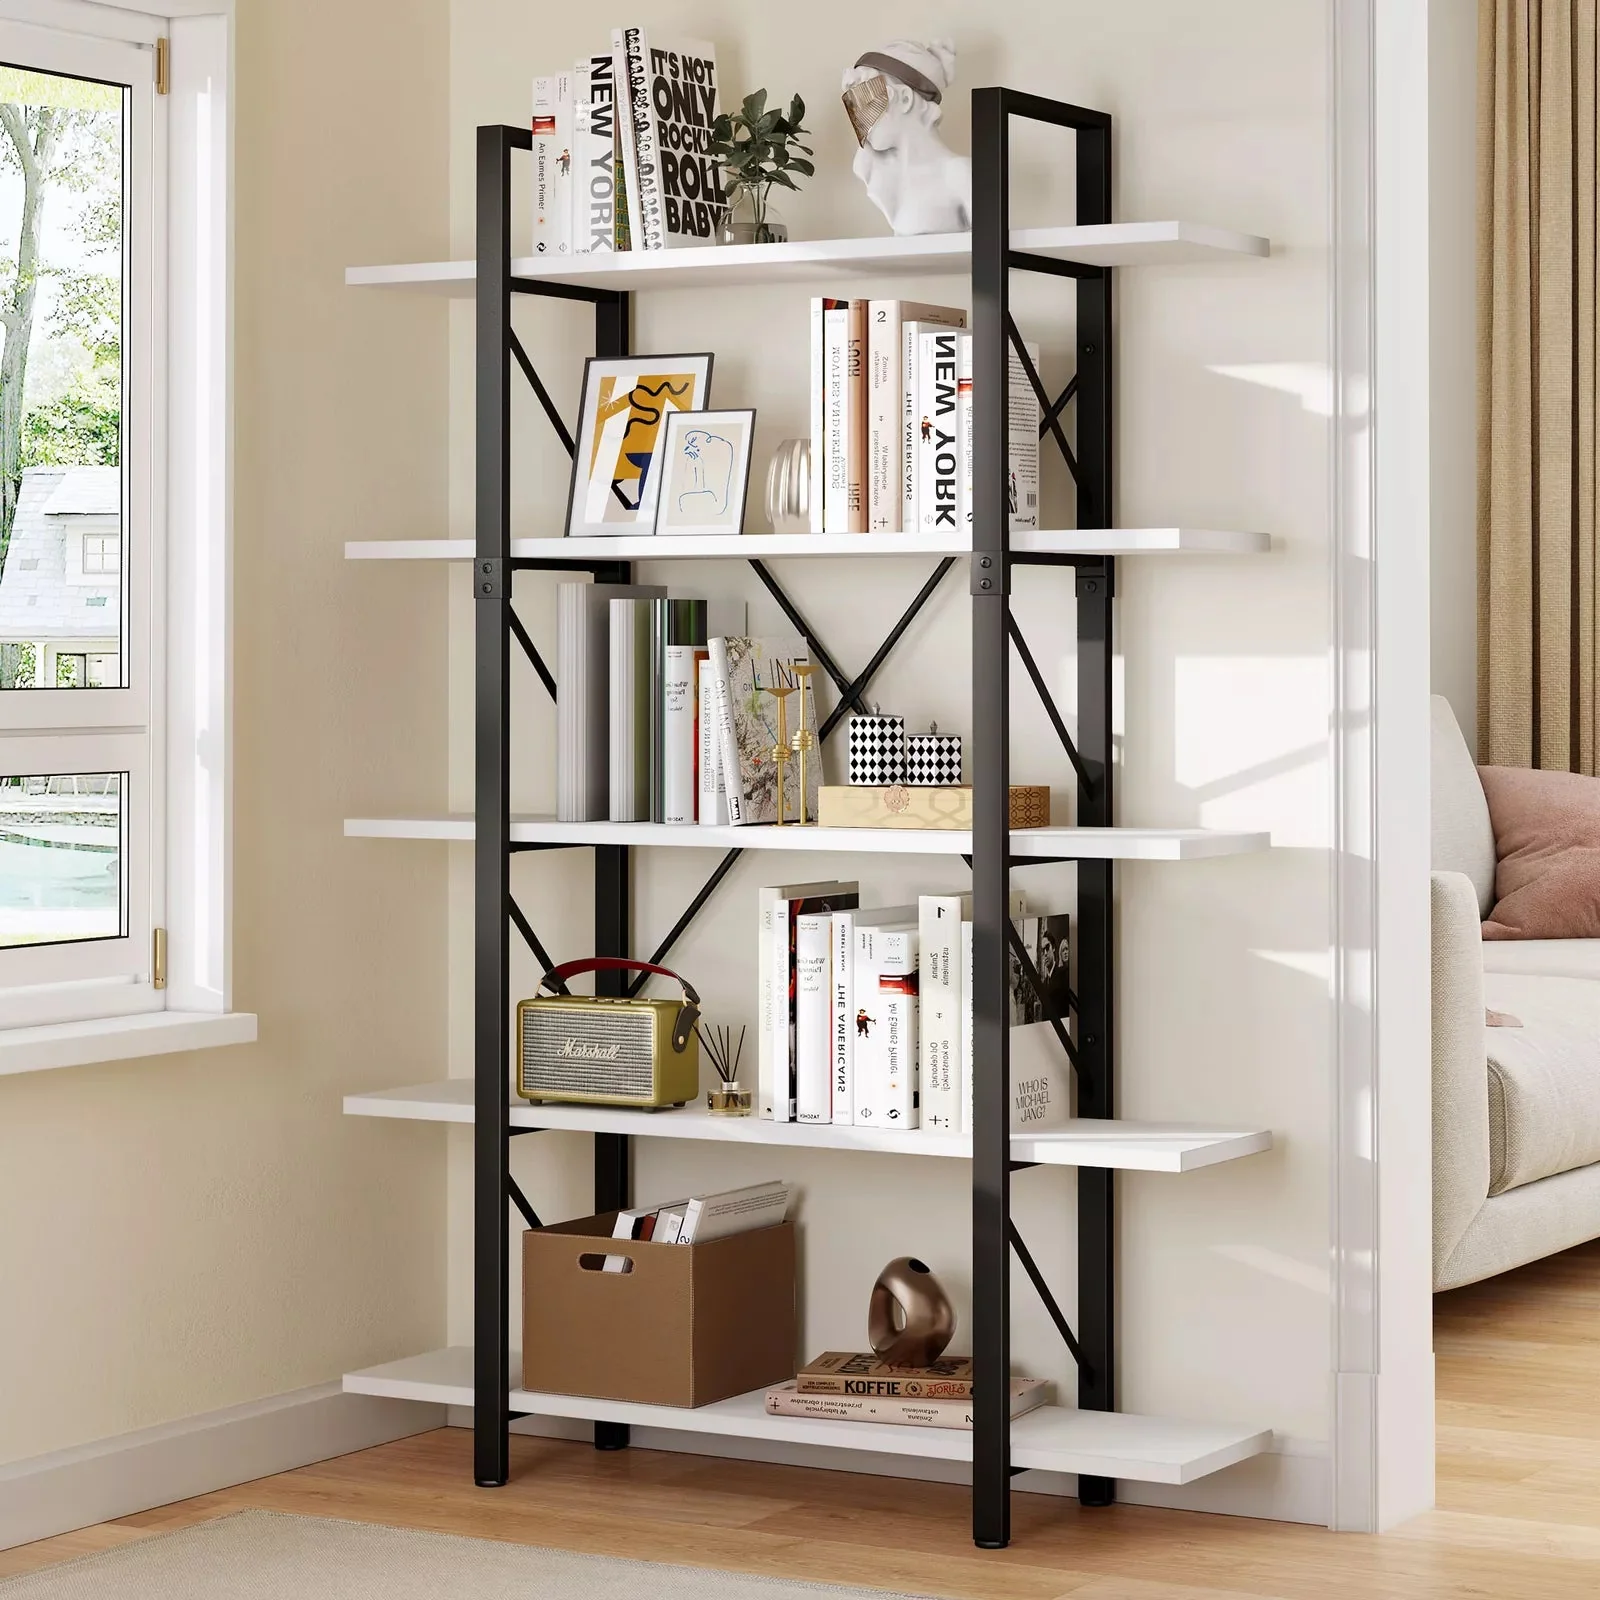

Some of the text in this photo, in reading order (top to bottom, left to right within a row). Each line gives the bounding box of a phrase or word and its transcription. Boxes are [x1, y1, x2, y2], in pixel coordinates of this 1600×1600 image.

[650, 48, 714, 86] IT'S NOT
[652, 75, 717, 130] ONLY
[590, 56, 613, 252] NEW YORK
[538, 143, 546, 210] An Eames Primer
[660, 150, 727, 204] ROLL
[877, 311, 887, 323] 2
[751, 658, 811, 690] LINE
[556, 1037, 621, 1062] Marshall
[1018, 1077, 1048, 1095] WHO IS
[1015, 1091, 1052, 1110] MICHAEL
[1021, 1105, 1046, 1122] JANG?
[844, 1380, 901, 1395] KOFFIE
[926, 1381, 965, 1398] STORIES
